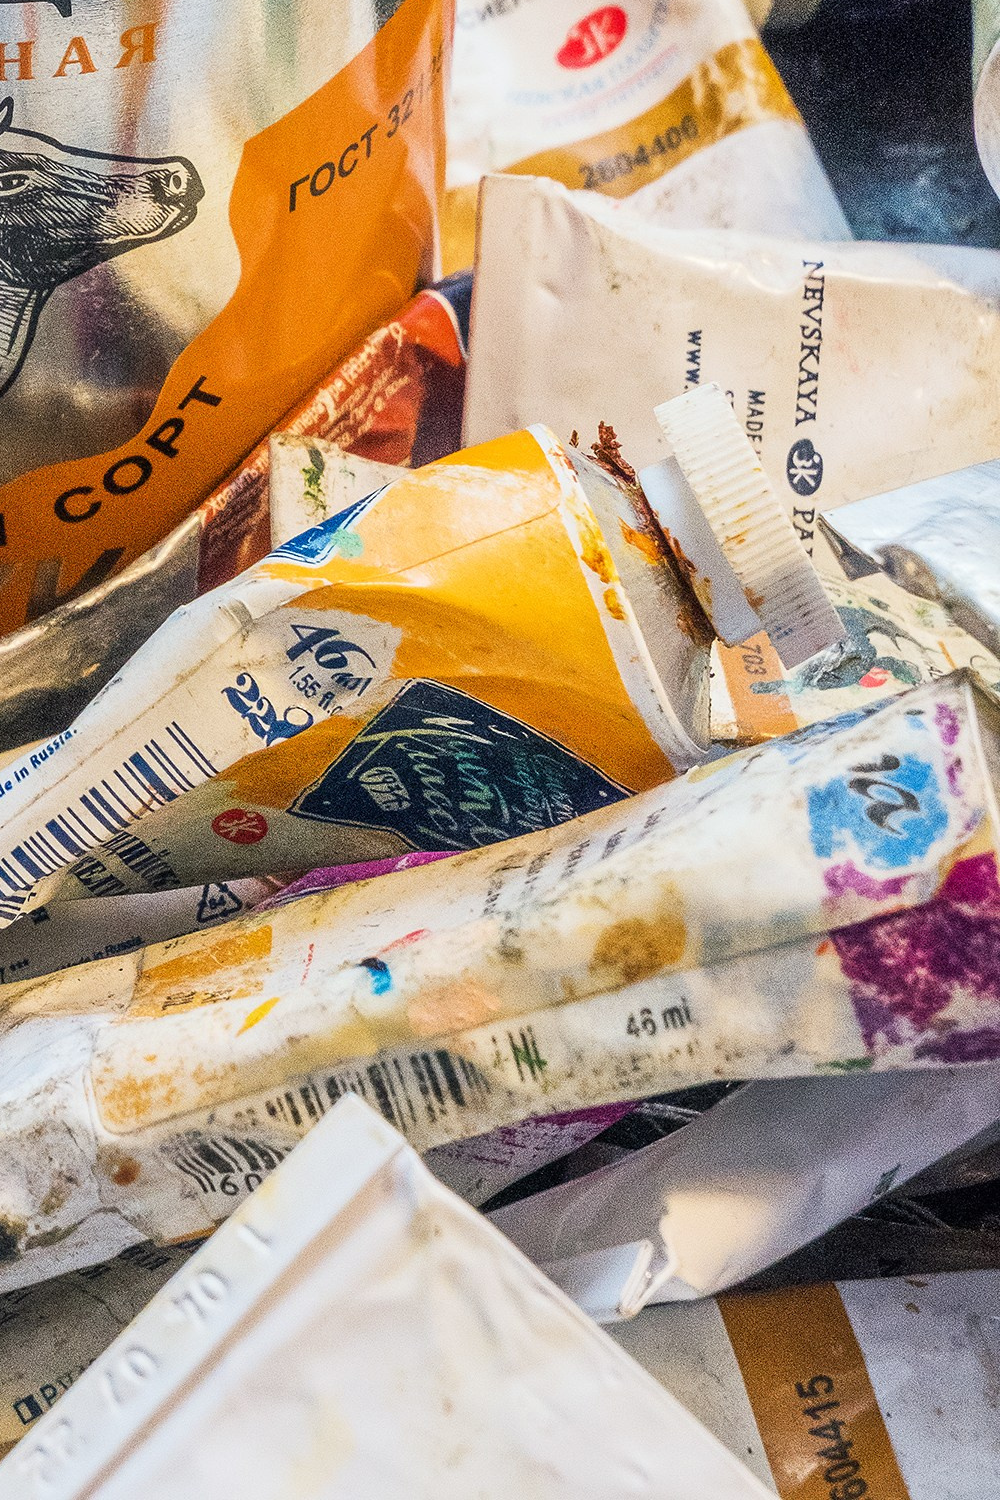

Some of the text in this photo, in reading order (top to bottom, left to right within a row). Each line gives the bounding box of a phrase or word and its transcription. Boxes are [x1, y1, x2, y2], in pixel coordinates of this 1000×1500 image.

[289, 122, 378, 213] ГОСТ
[795, 259, 826, 428] NEVSKAYA
[746, 389, 766, 443] MADE
[55, 376, 224, 526] СОРТ
[285, 623, 377, 671] 46
[288, 665, 319, 700] 1.55
[14, 766, 30, 786] in
